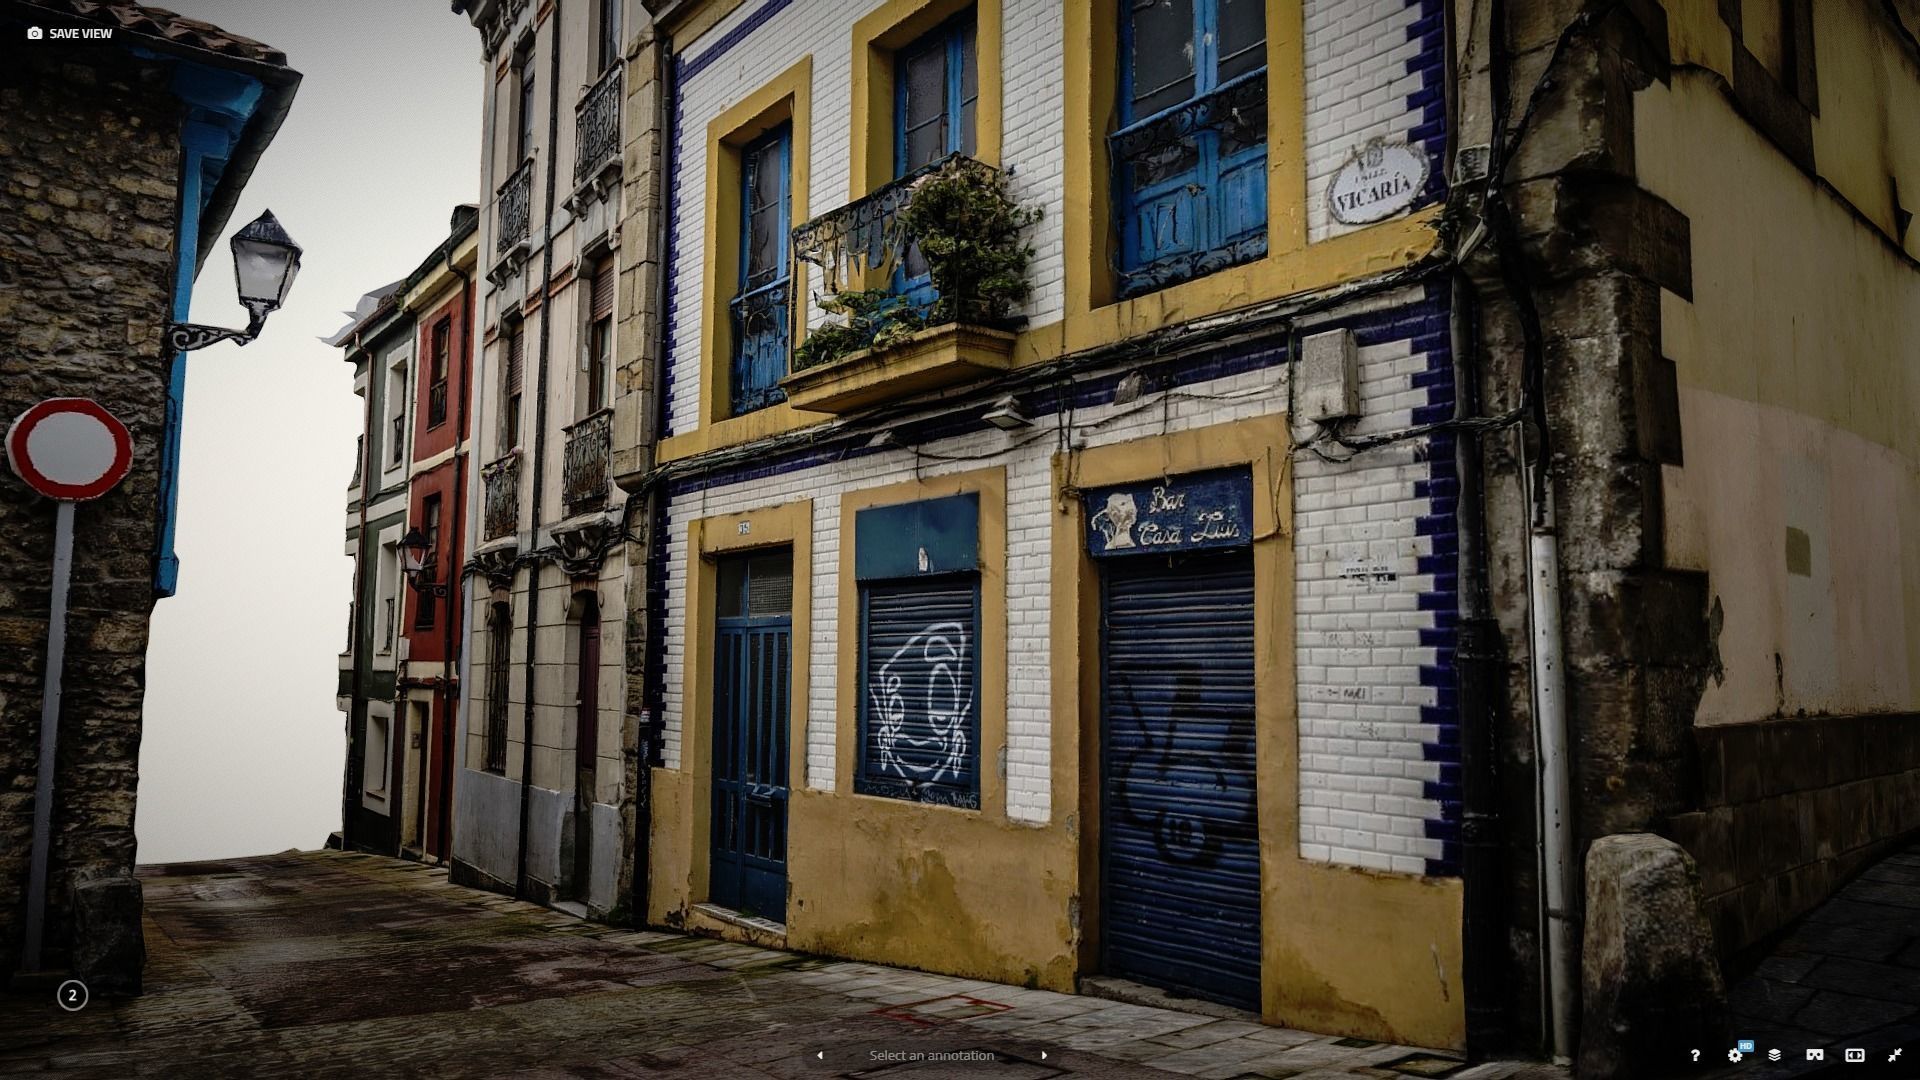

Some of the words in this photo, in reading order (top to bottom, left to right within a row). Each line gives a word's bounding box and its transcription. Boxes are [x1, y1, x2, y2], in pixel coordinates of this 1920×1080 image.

[1337, 171, 1411, 212] VICARÍA
[1148, 486, 1186, 514] Bar
[1138, 521, 1184, 546] Casa
[1190, 511, 1240, 543] Luis
